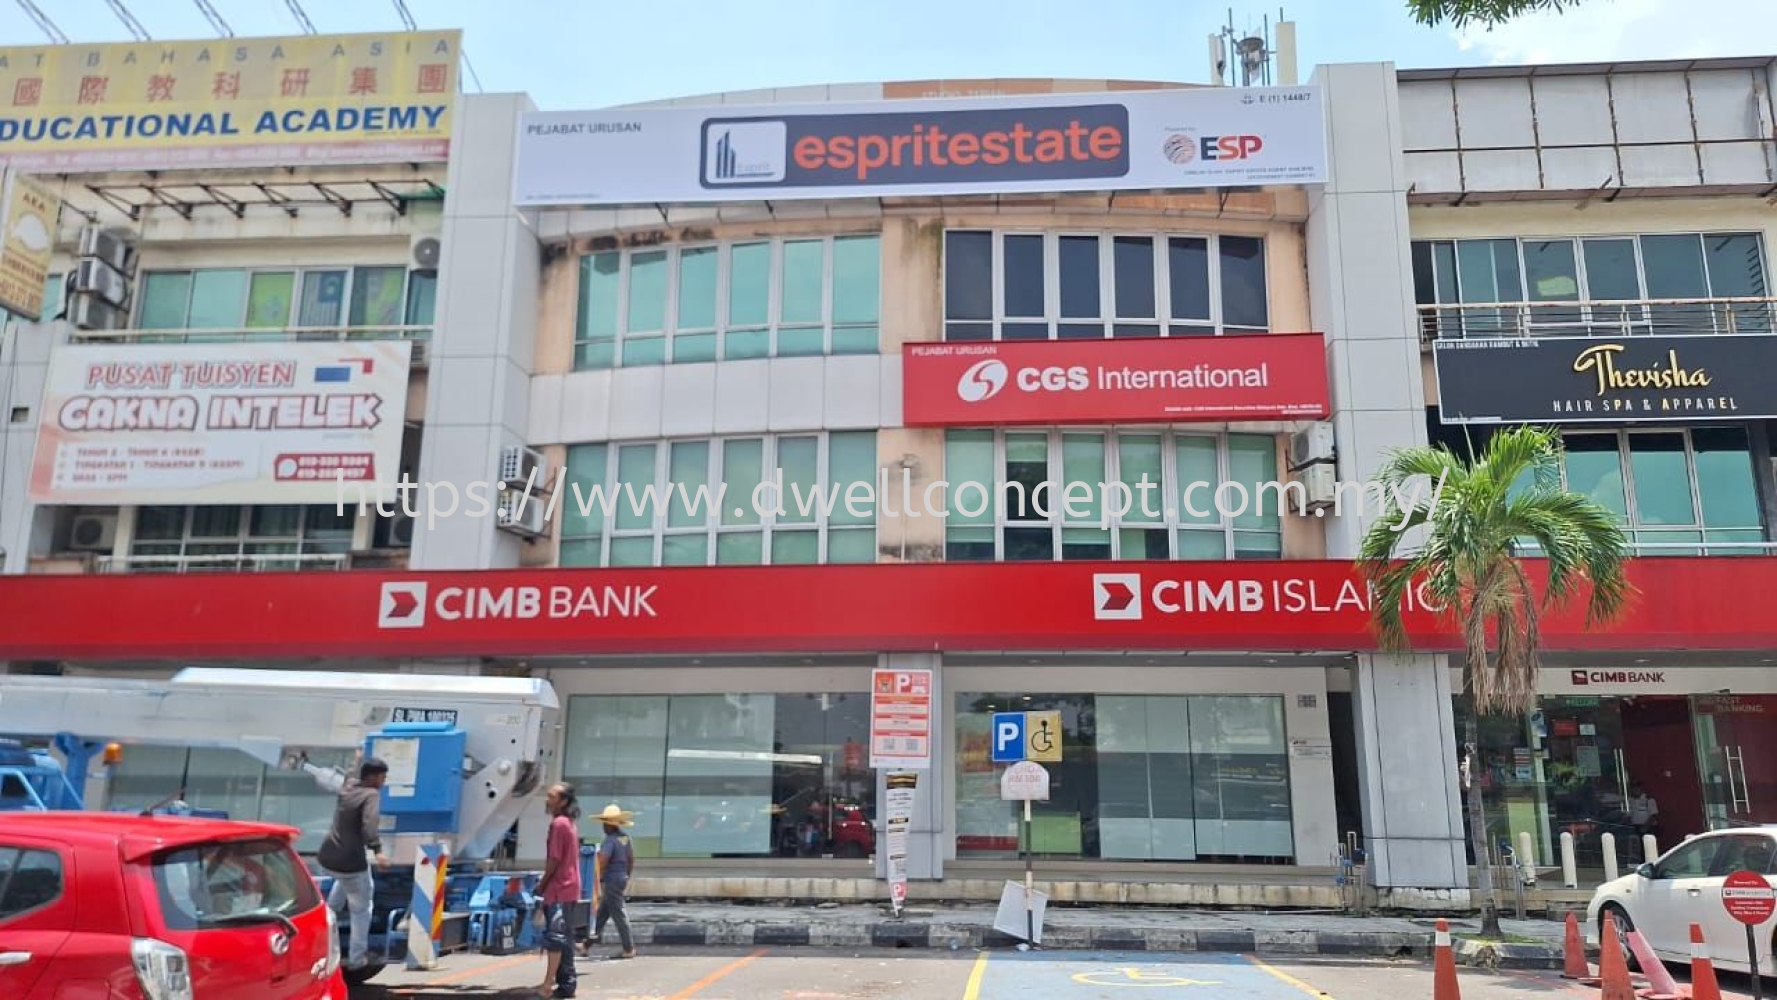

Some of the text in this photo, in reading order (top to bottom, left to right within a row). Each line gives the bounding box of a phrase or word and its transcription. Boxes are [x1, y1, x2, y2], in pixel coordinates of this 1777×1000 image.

[87, 46, 285, 67] BAHASA
[332, 39, 449, 57] ASIA
[0, 105, 447, 141] DUCATIONAL ACADEMY
[527, 121, 642, 136] PEJABAT URUSAN
[793, 120, 1121, 180] espritestate
[1200, 134, 1263, 161] ESP
[87, 360, 296, 388] PUSAT TUISYEN
[1017, 363, 1268, 391] CGS International
[1573, 343, 1713, 397] Thevisha
[206, 393, 383, 430] INTELEK
[1552, 399, 1593, 412] HAIR
[1603, 399, 1633, 412] SPA
[1662, 397, 1739, 412] APPAREL
[435, 584, 659, 620] CIMB BANK
[1151, 580, 1264, 613] CIMB
[1590, 671, 1666, 683] CIMB BANK
[998, 722, 1019, 751] P
